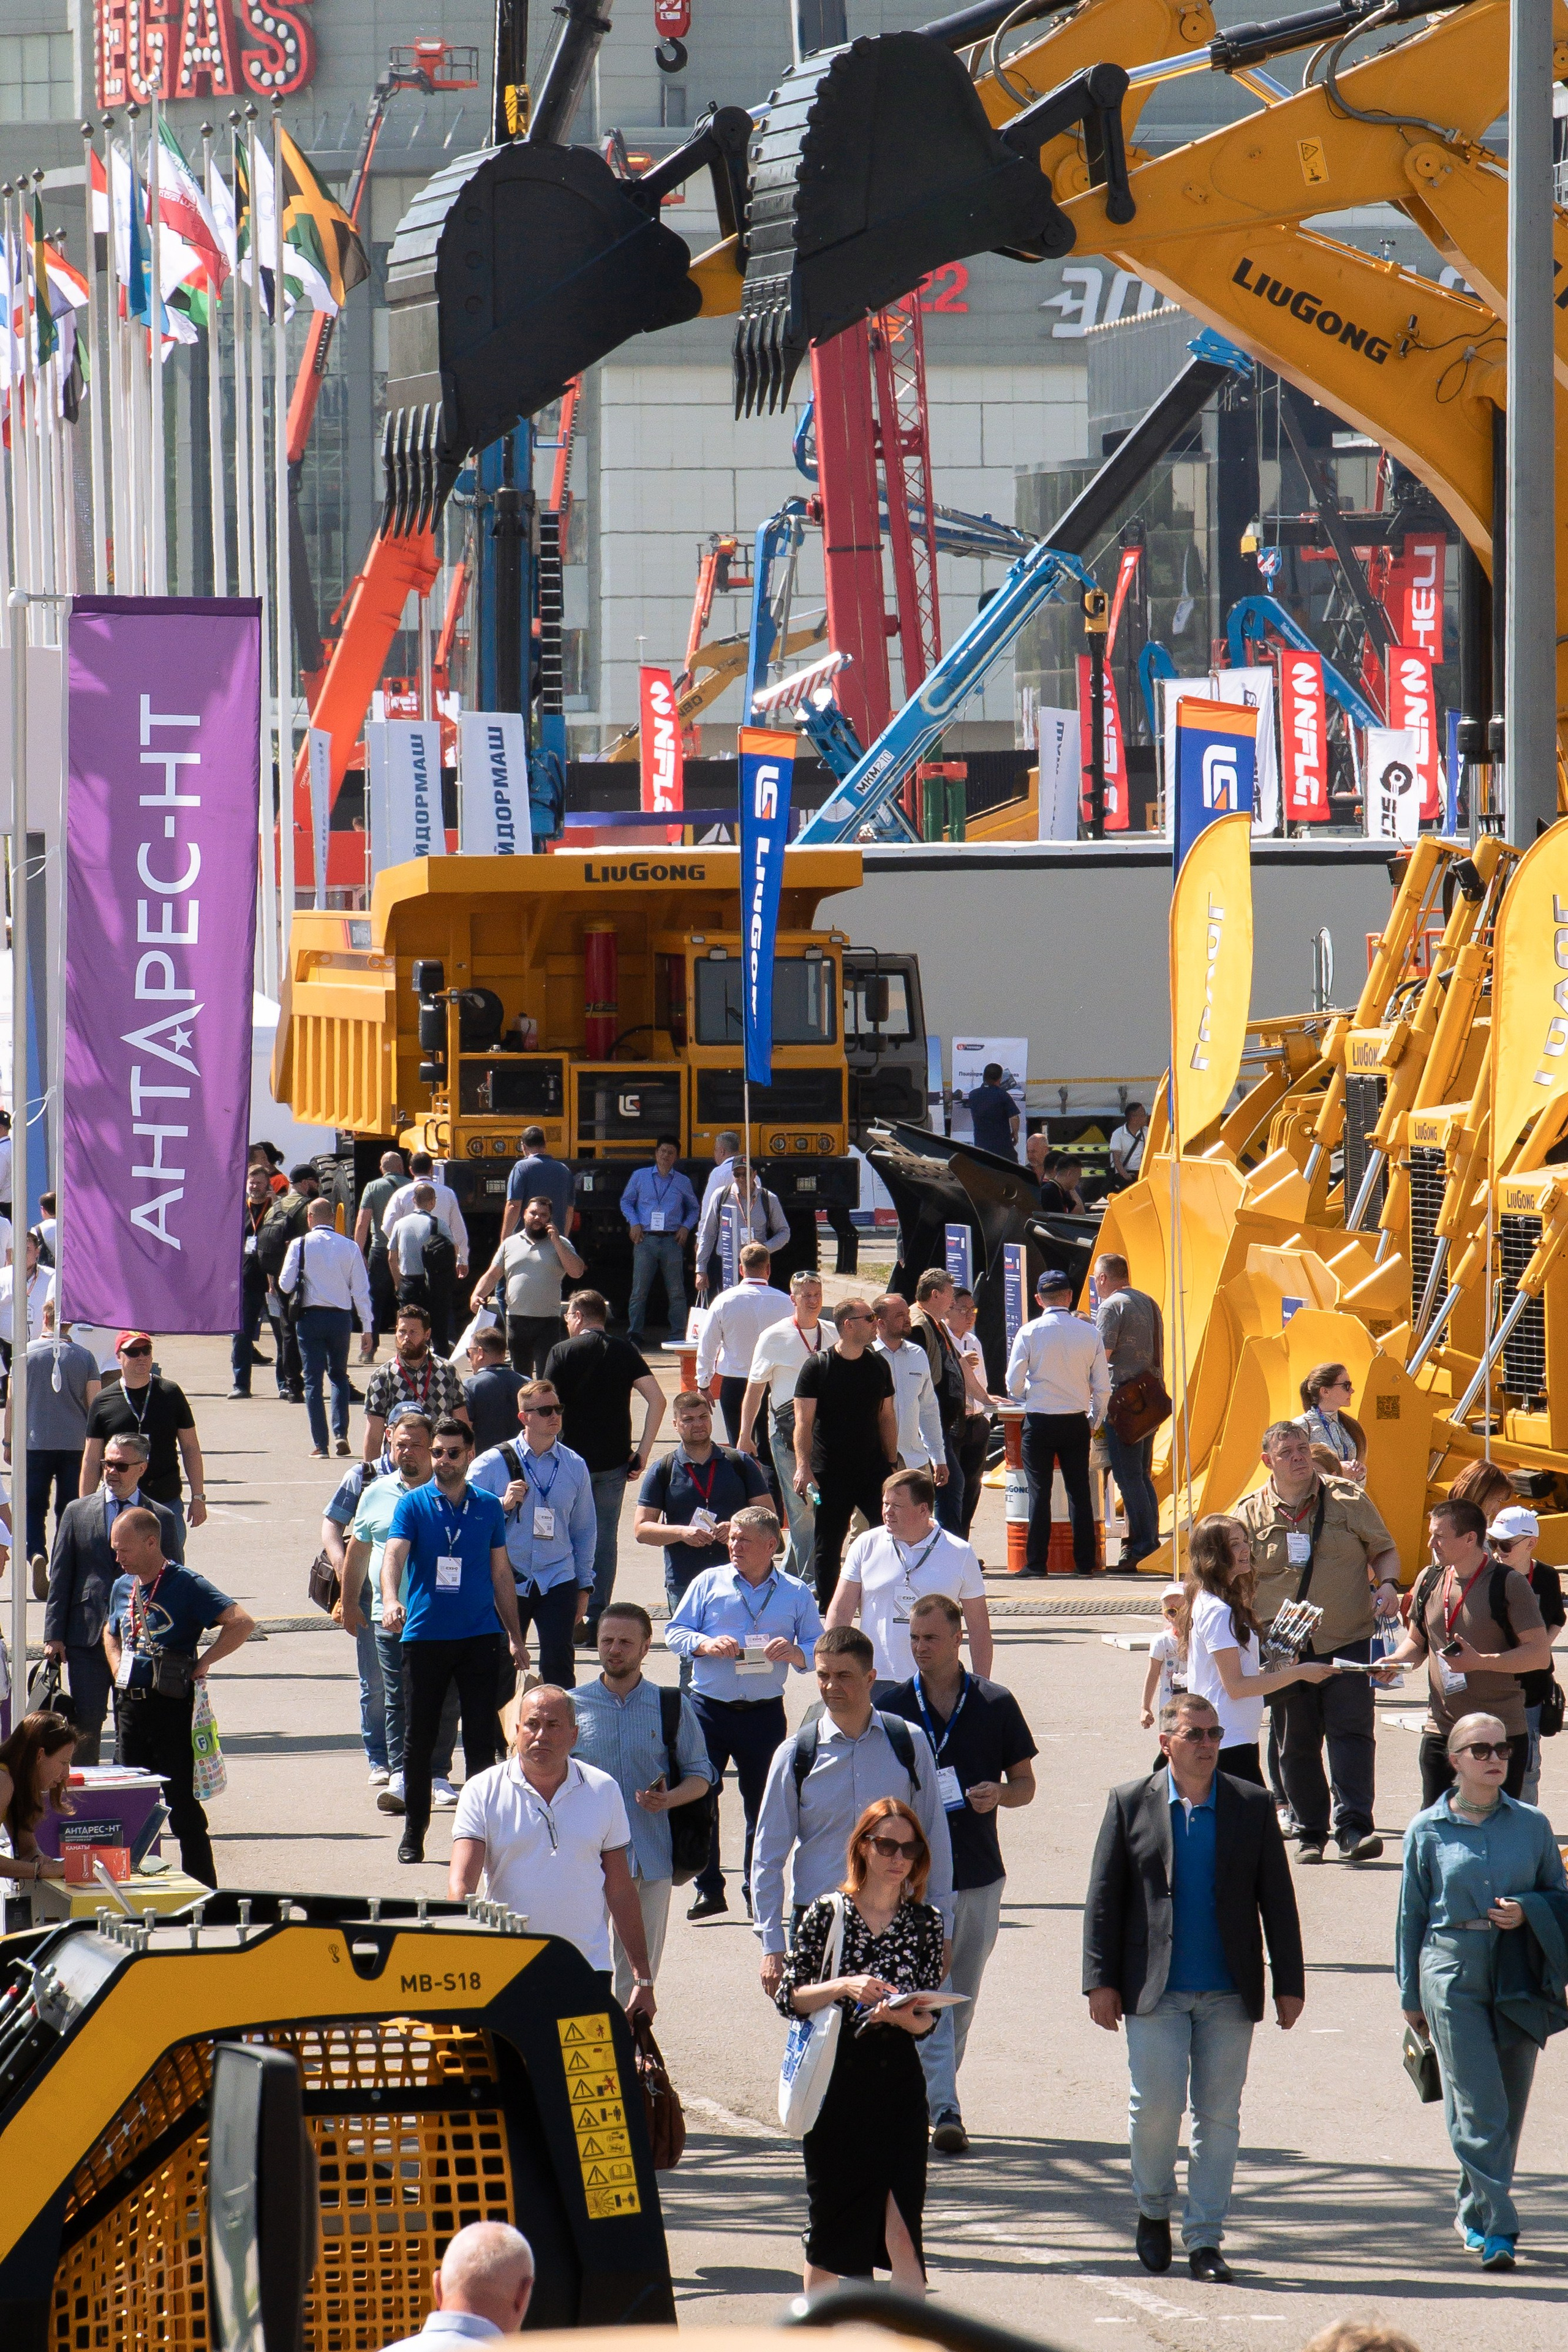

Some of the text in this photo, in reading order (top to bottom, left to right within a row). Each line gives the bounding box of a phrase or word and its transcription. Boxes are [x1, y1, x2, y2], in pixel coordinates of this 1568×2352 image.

[1231, 257, 1392, 365] LIUGONG
[1293, 696, 1320, 806] NFLG
[584, 862, 705, 883] LIUGONG
[119, 694, 206, 1251] АНТАРЕС-НТ
[1414, 1121, 1438, 1142] LIUGONG
[1506, 1189, 1535, 1210] LIUGONG
[64, 1824, 122, 1835] АНТАРЕС-НТ
[401, 1972, 481, 1993] MB-S18
